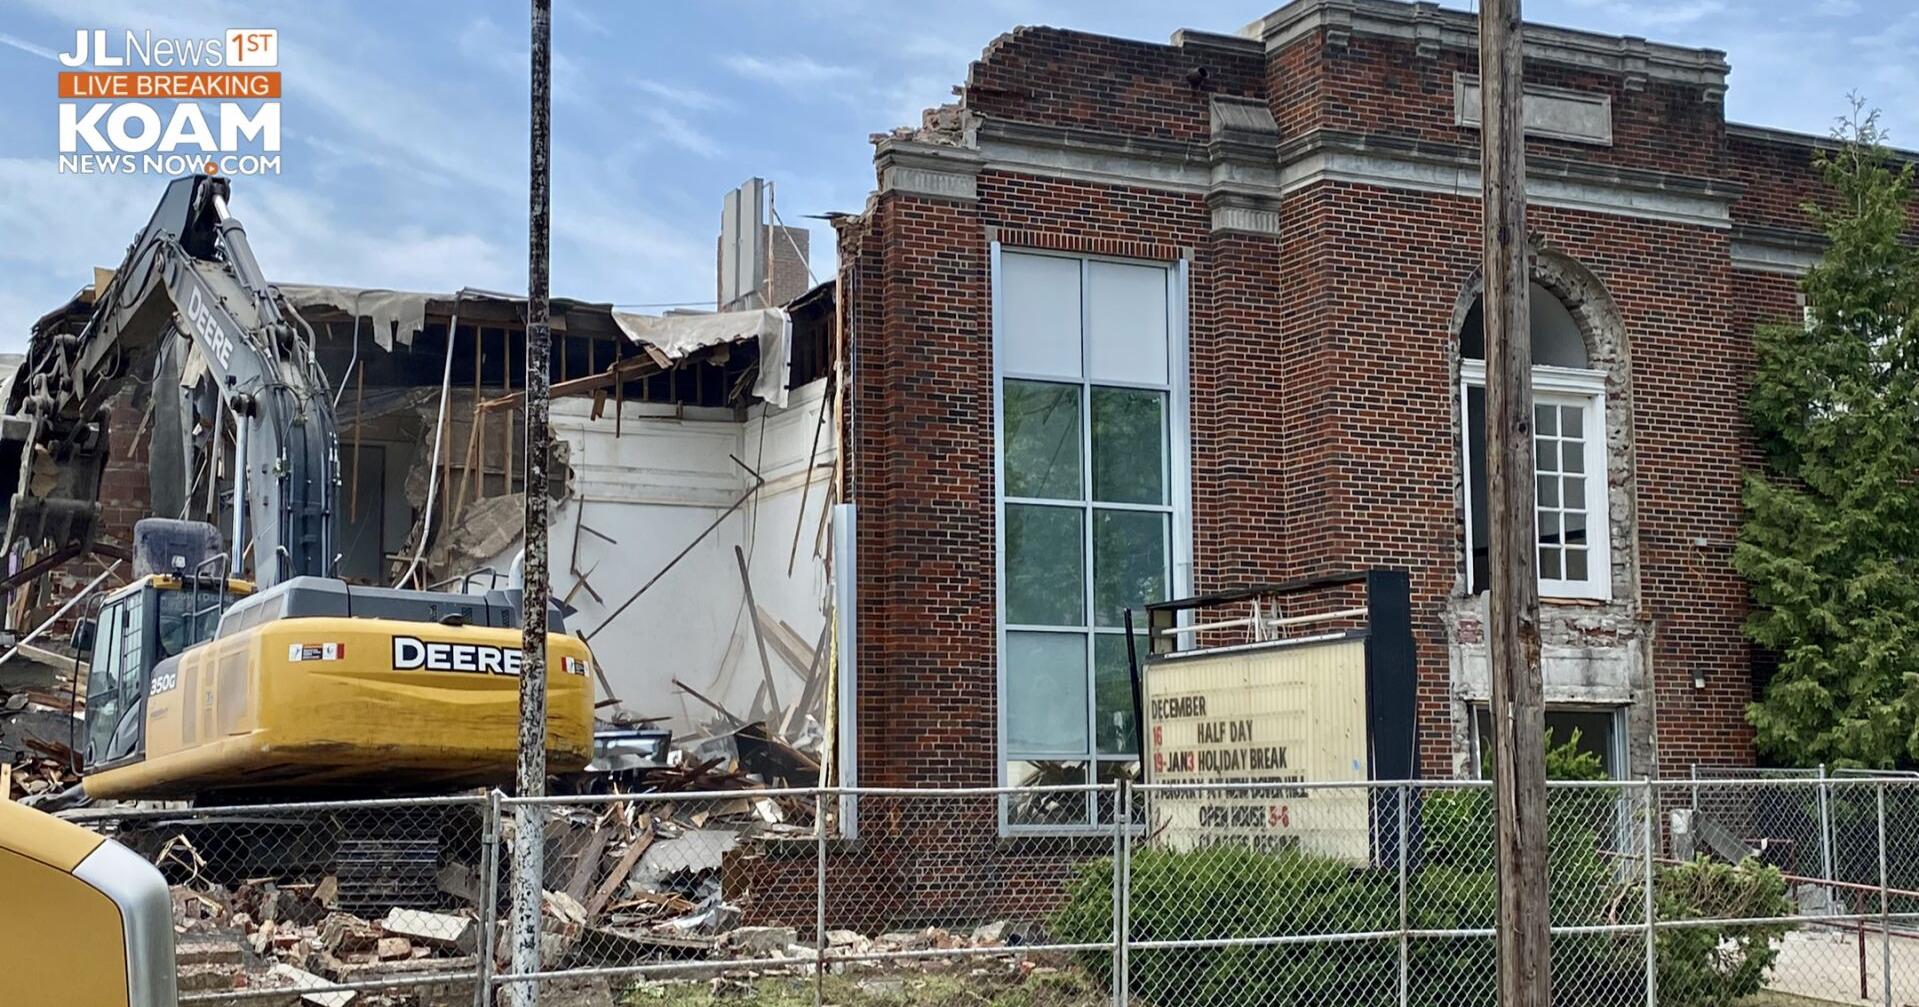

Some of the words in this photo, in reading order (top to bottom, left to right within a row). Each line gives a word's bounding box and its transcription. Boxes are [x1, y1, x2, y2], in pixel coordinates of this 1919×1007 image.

[188, 286, 233, 370] DEERE
[393, 636, 523, 675] DEERE
[150, 673, 176, 696] 350G
[1151, 695, 1207, 720] DECEMBER
[1153, 725, 1163, 747] 16
[1197, 721, 1226, 745] HALF
[1229, 719, 1253, 743] DAY
[1198, 749, 1248, 772] HOLIDAY
[1250, 746, 1288, 770] BREAK
[1199, 805, 1229, 828] OPEN
[1230, 805, 1267, 828] HOUSE
